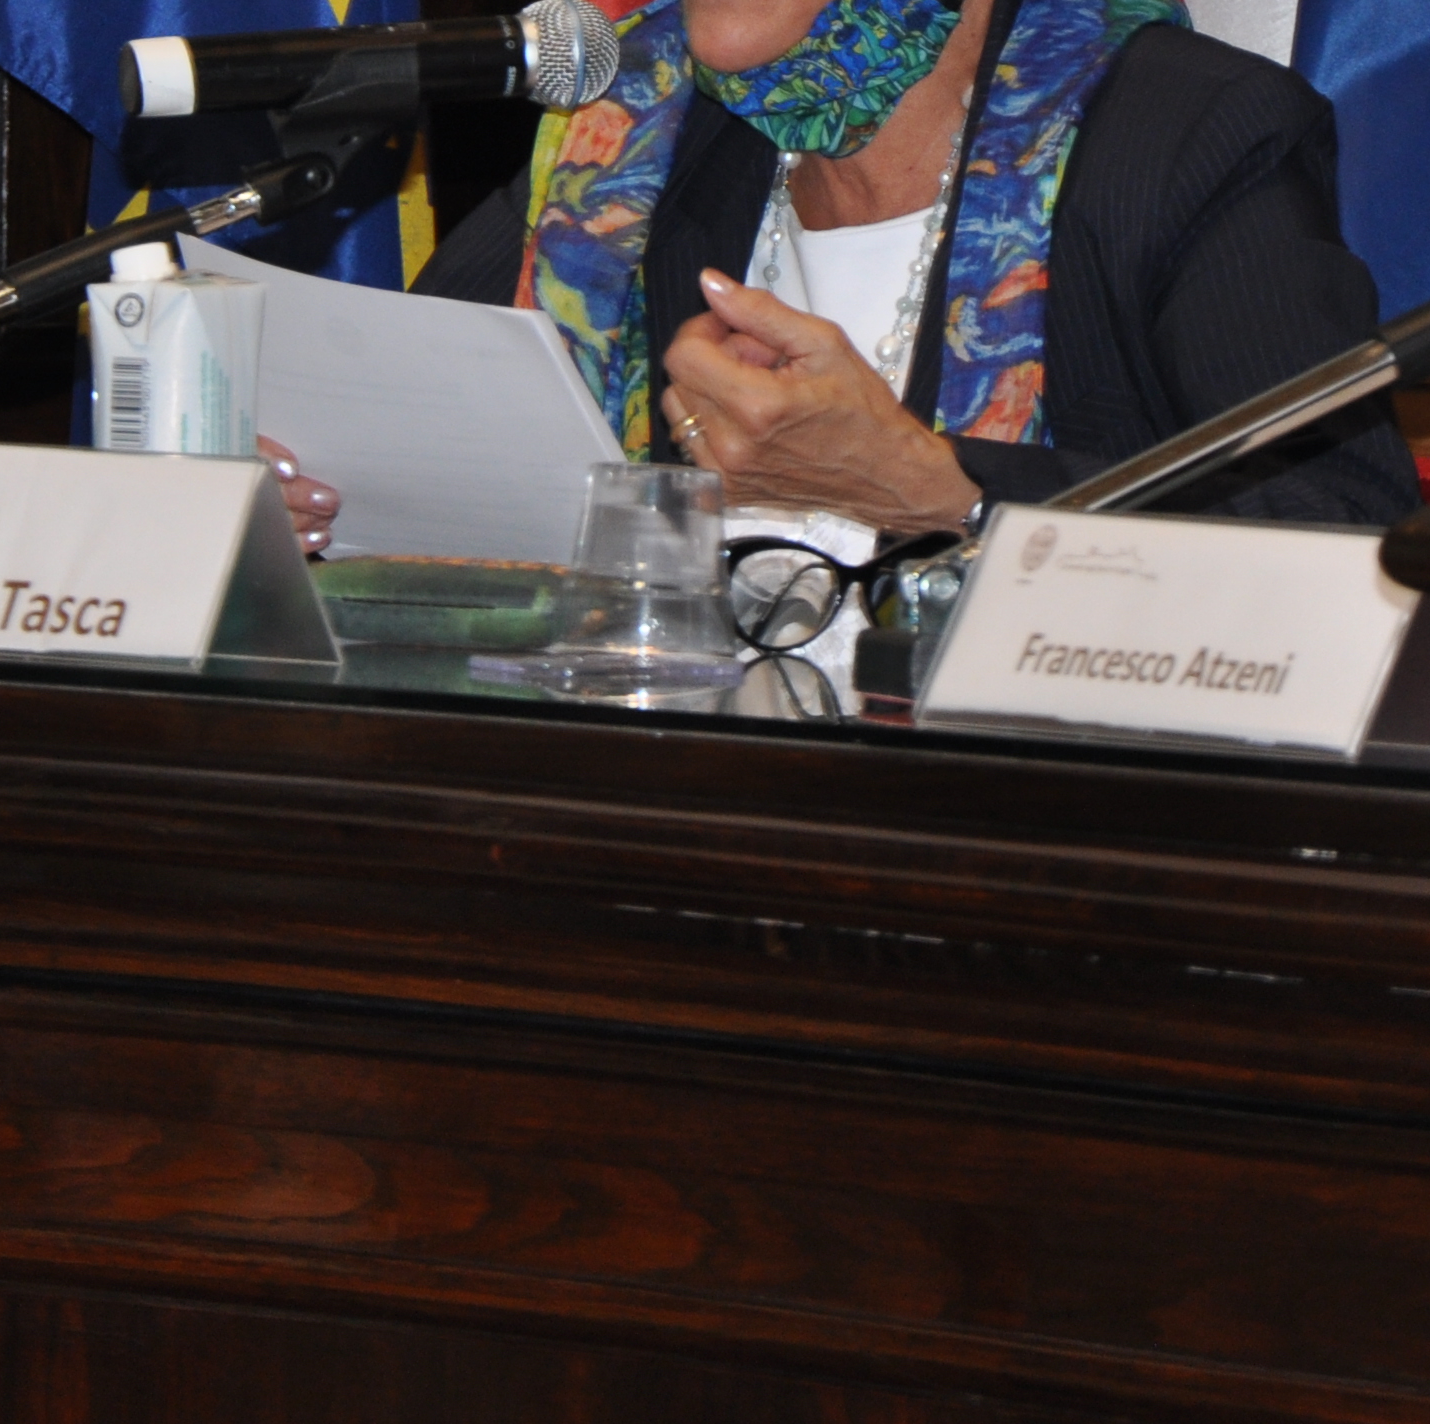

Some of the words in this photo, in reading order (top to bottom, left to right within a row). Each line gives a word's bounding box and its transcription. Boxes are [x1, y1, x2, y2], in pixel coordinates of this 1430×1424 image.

[0, 580, 128, 637] Tasca
[1016, 632, 1177, 685] Francesco
[1179, 647, 1296, 695] Atzeni
